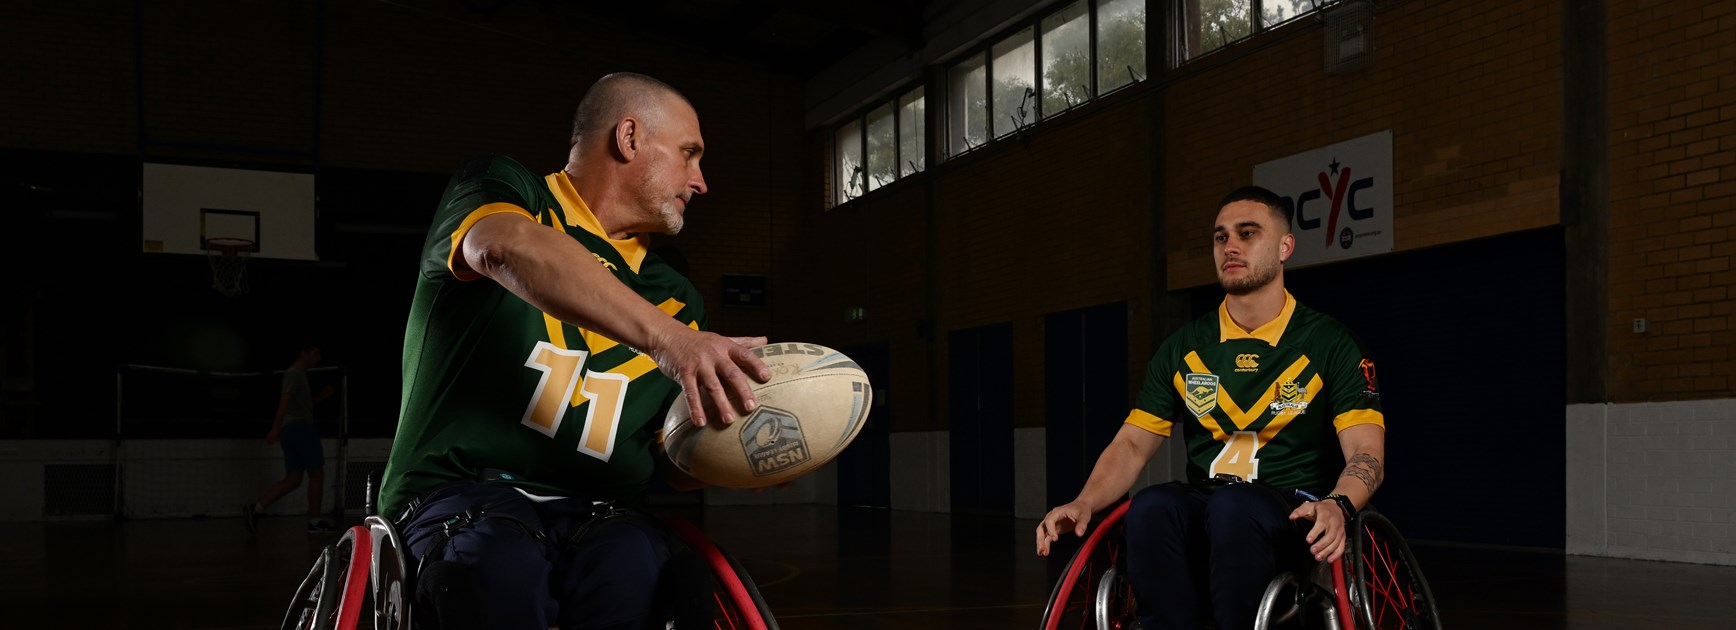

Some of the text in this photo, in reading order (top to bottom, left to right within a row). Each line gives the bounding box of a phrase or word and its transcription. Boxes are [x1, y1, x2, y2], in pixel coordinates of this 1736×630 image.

[520, 340, 630, 463] 11
[758, 447, 804, 473] NSW
[1209, 430, 1259, 484] 4
